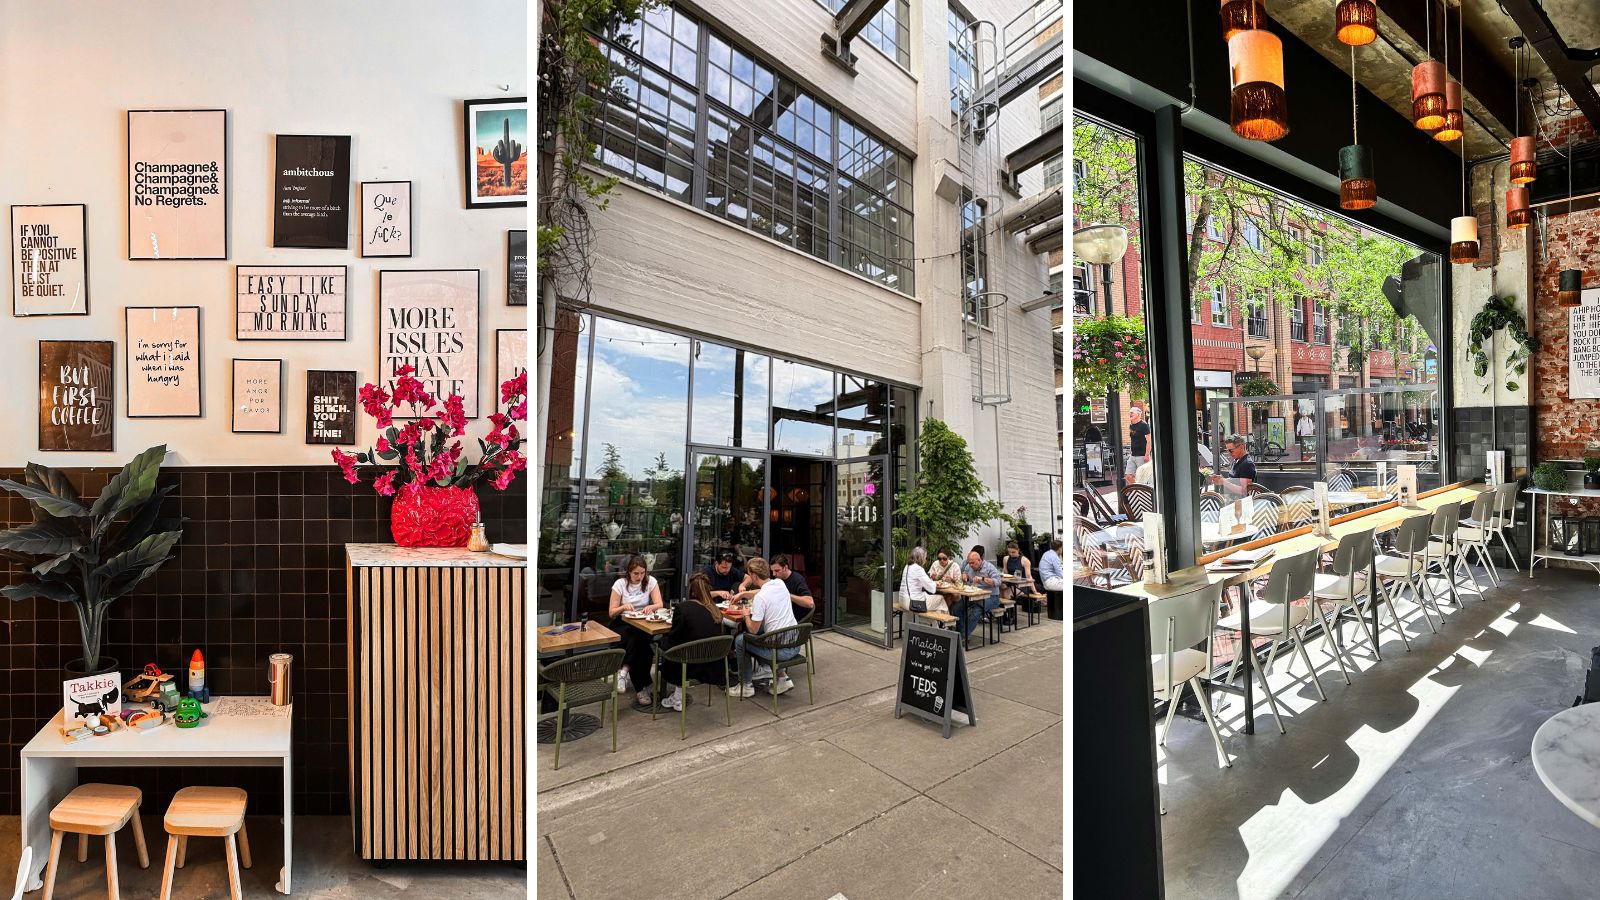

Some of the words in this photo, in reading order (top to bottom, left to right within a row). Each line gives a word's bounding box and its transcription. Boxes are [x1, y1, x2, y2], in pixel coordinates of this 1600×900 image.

[134, 161, 219, 175] Champagne&
[283, 166, 335, 177] ambitchous
[134, 172, 219, 186] Champagne&
[134, 183, 219, 197] Champagne&
[134, 195, 152, 206] No
[155, 195, 207, 208] Regrets.
[20, 224, 29, 237] IF
[31, 224, 50, 236] YOU
[20, 236, 59, 249] CANNOT
[21, 248, 33, 261] BE
[48, 260, 60, 273] AT
[22, 285, 34, 296] BE
[36, 284, 66, 298] QUIET.
[248, 276, 286, 295] EASY
[300, 276, 334, 295] LIKE
[260, 294, 319, 313] SUNDAY
[1578, 306, 1590, 314] HIP
[254, 312, 328, 331] MORNING
[387, 306, 456, 330] MORE
[1573, 314, 1586, 322] THE
[1573, 322, 1586, 330] HIP
[1572, 330, 1586, 338] YOU
[138, 338, 150, 349] i'm
[152, 341, 174, 352] sorry
[174, 340, 188, 348] for
[387, 332, 464, 355] ISSUES
[1573, 338, 1591, 346] ROCK
[1592, 336, 1597, 344] IT
[135, 350, 162, 362] what
[1573, 346, 1591, 354] BANG
[1572, 352, 1600, 362] JUMPED
[141, 363, 162, 372] when
[386, 356, 452, 378] THAN
[1586, 361, 1598, 369] THE
[60, 365, 90, 386] BUT
[1581, 369, 1592, 377] THE
[147, 373, 180, 387] hungry
[313, 396, 340, 405] SHIT
[313, 404, 351, 413] BITCH.
[51, 406, 101, 426] COFFEE
[313, 412, 337, 421] YOU
[313, 420, 325, 430] IS
[312, 429, 342, 438] FINE!
[850, 505, 877, 522] TEDS
[70, 678, 114, 694] Takkie
[910, 674, 937, 695] TEDS
